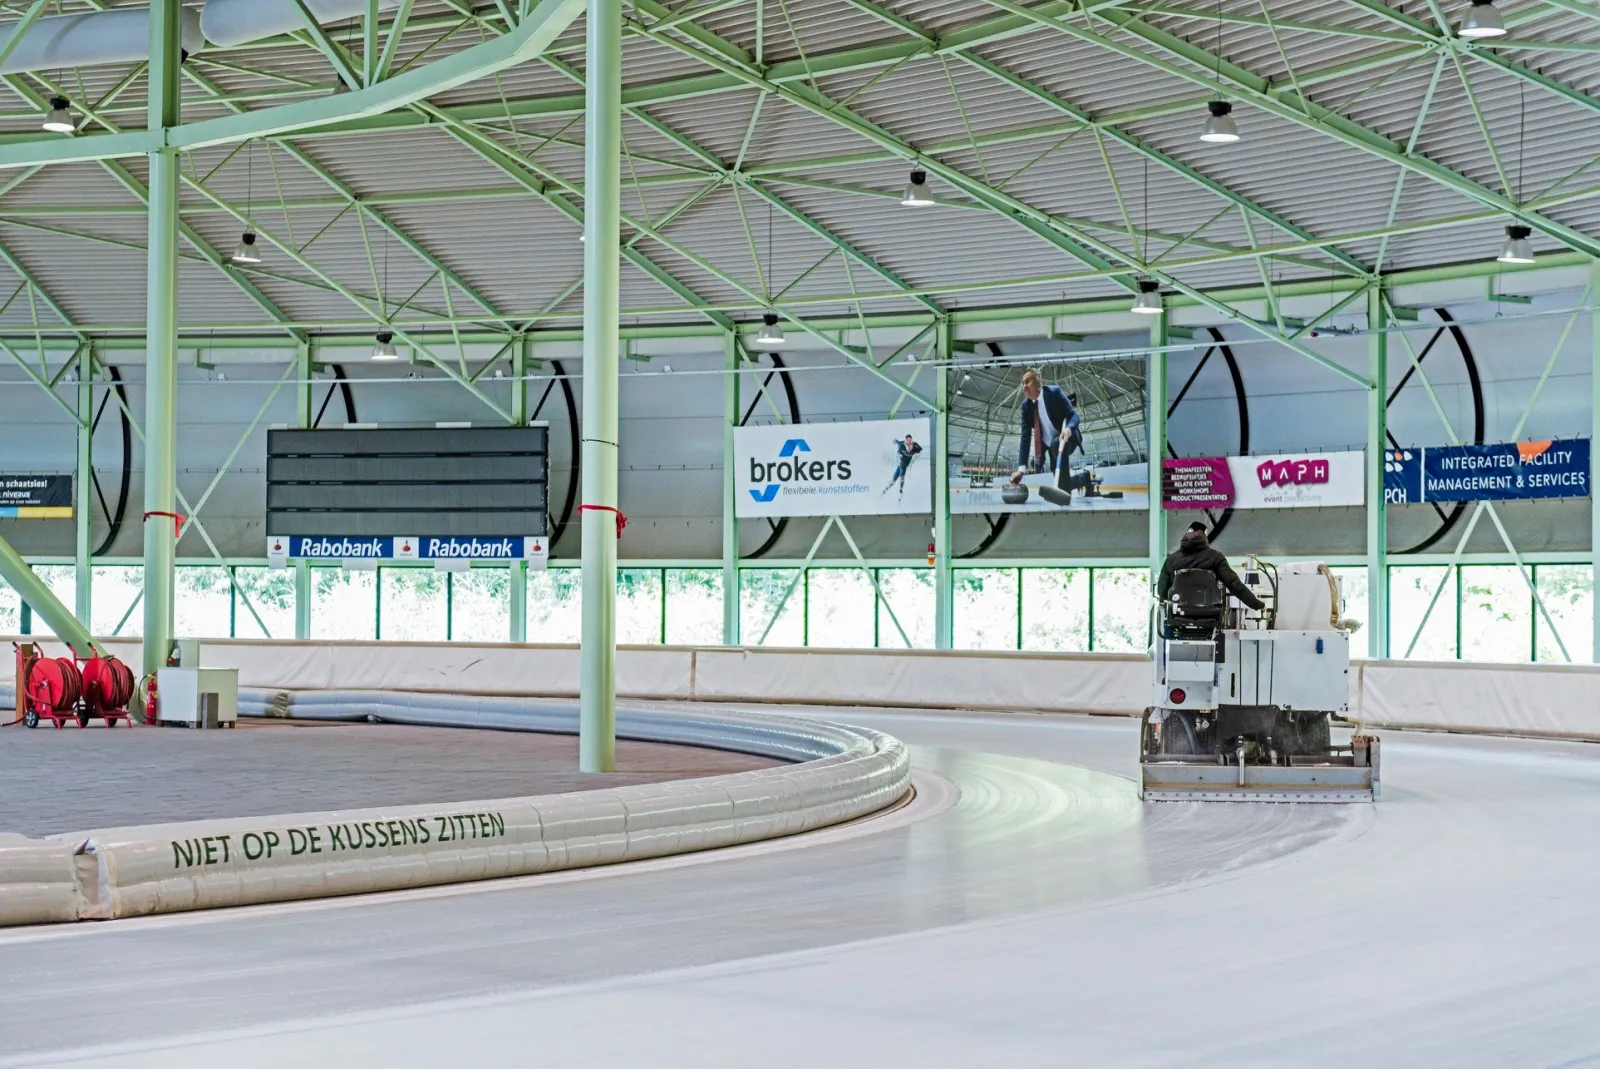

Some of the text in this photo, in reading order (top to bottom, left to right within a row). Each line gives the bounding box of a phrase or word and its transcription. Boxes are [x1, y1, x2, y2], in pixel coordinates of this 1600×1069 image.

[750, 455, 852, 483] brokers
[1441, 451, 1572, 470] INTEGRATED FACILITY
[1262, 464, 1325, 481] MAPH
[1428, 472, 1586, 491] MANAGEMENT & SERVICES
[6, 479, 47, 488] schaatsles!
[783, 484, 870, 495] flexibele kunststoffen
[3, 490, 30, 498] niveaus
[1384, 488, 1407, 504] PCH
[300, 538, 513, 557] Rabobank Rabobank
[171, 812, 505, 868] NIET OP DE KUSSENS ZITTEN
